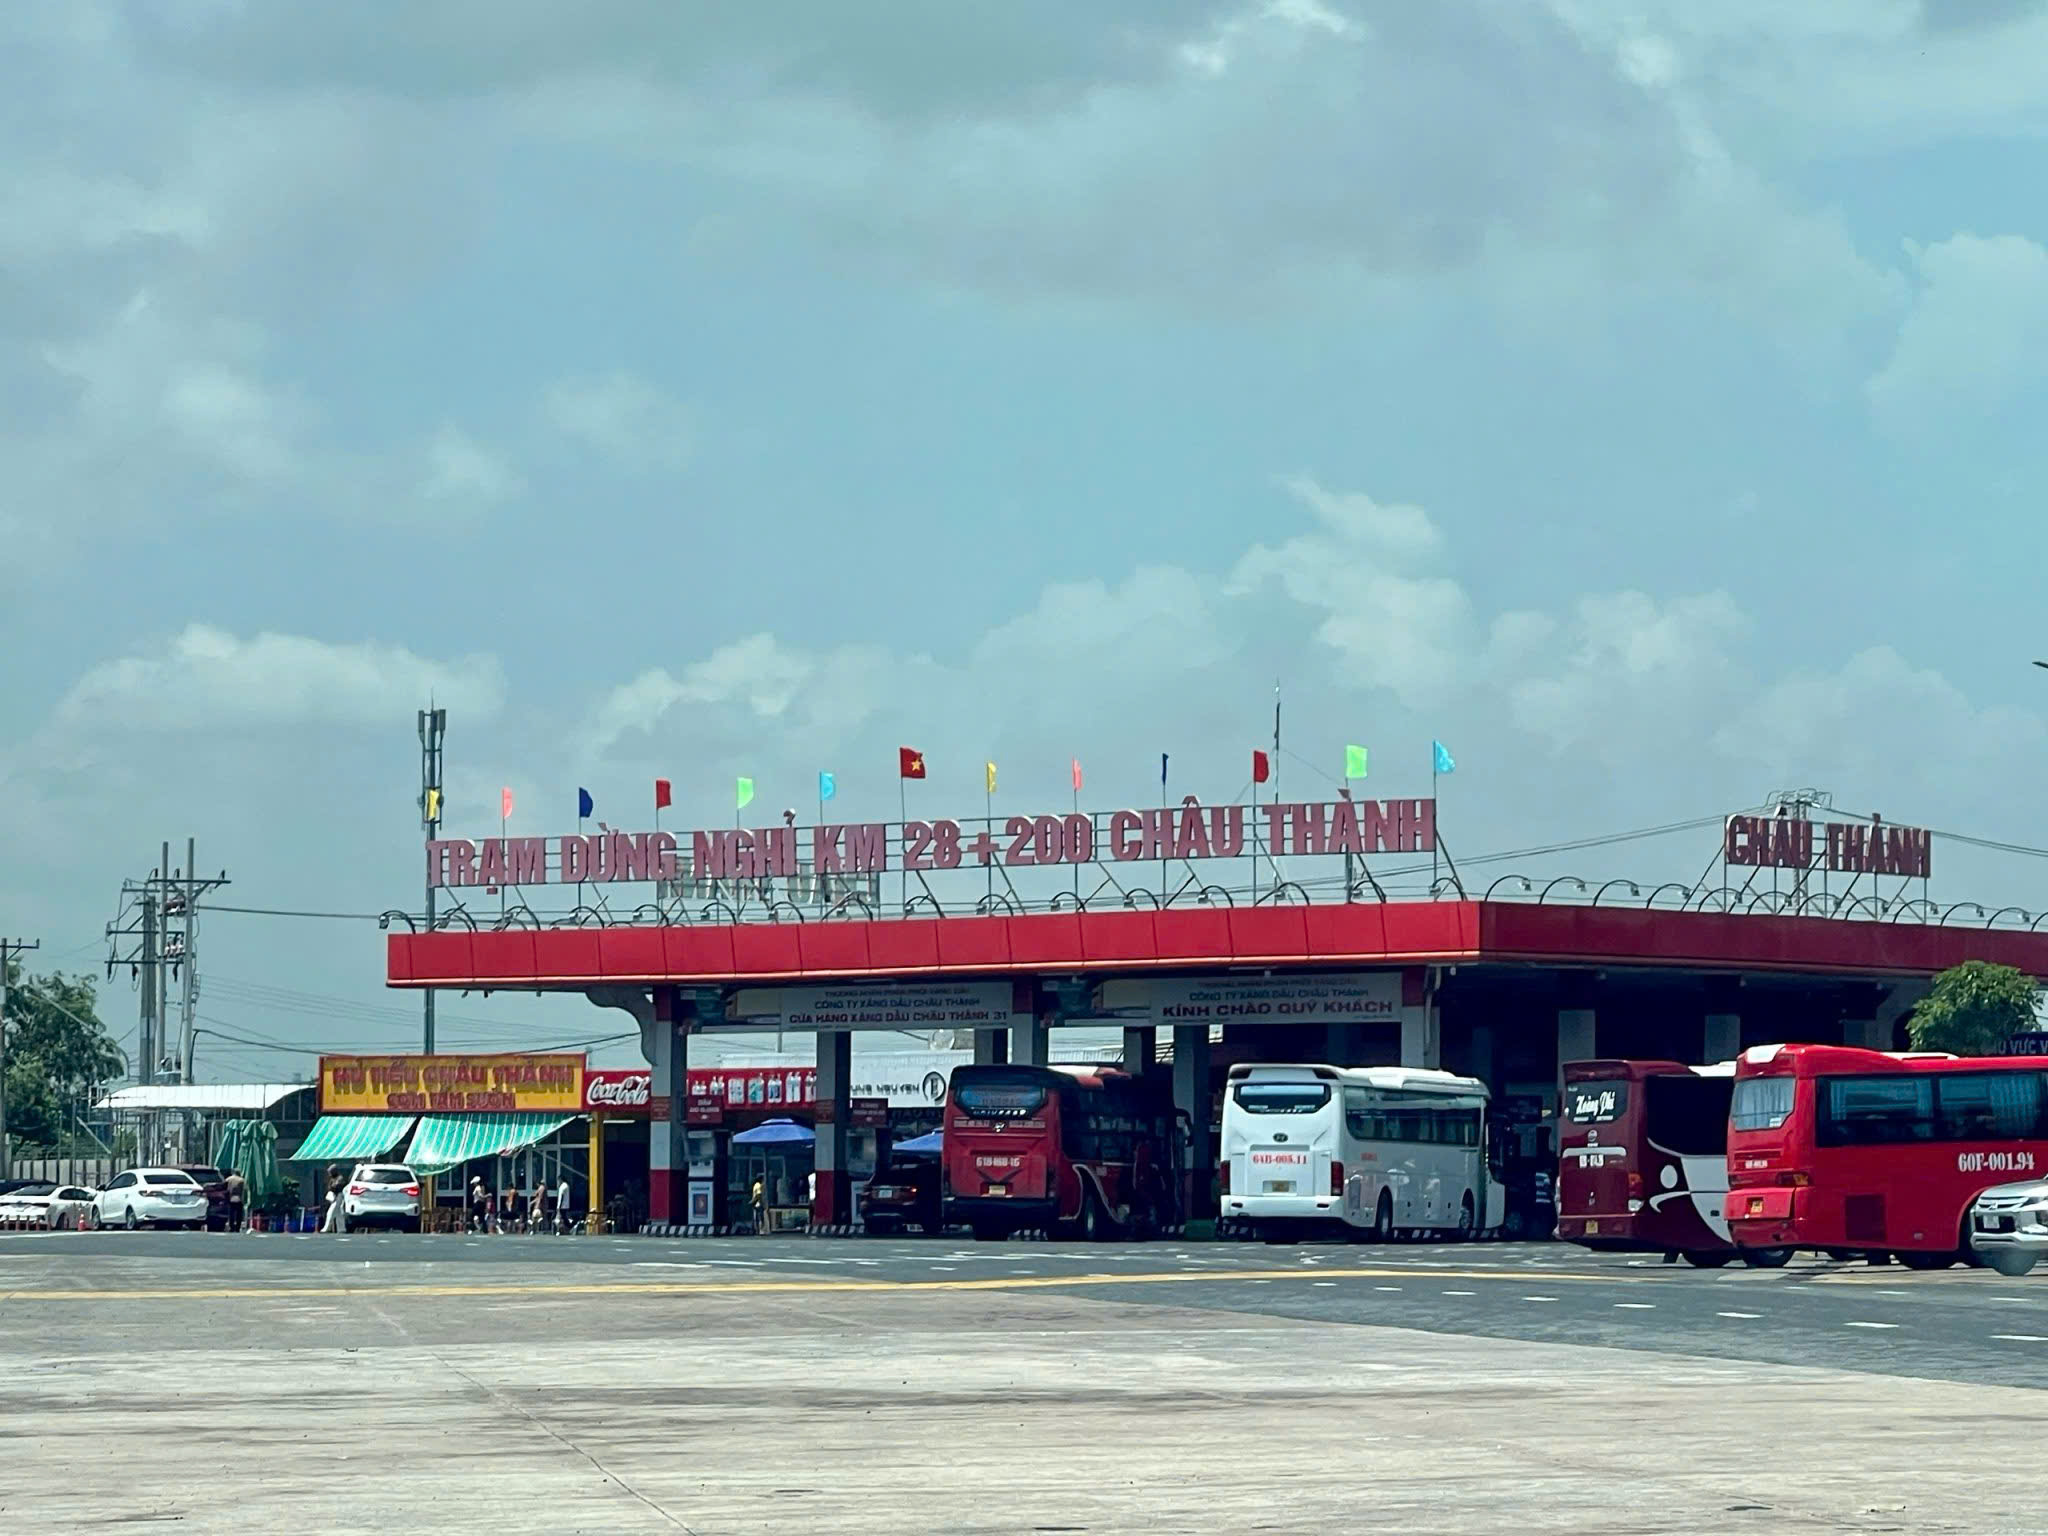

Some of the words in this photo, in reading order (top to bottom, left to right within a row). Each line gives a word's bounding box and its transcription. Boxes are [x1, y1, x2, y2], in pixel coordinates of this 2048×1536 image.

[427, 838, 546, 895] TRẠM
[561, 822, 677, 883] DỪNG
[694, 808, 797, 880] NGHỈ
[813, 823, 887, 875] KM
[903, 812, 1093, 868] 28+200
[1110, 795, 1245, 862] CHÂU
[1262, 788, 1436, 855] THÀNH
[1726, 806, 1813, 869] CHÂU
[1825, 812, 1932, 878] THÀNH
[1163, 1003, 1210, 1017] KÍNH
[1216, 1001, 1272, 1016] CHÀO
[1323, 998, 1393, 1013] KHÁCH
[1957, 1151, 2035, 1173] 60F-001.94
